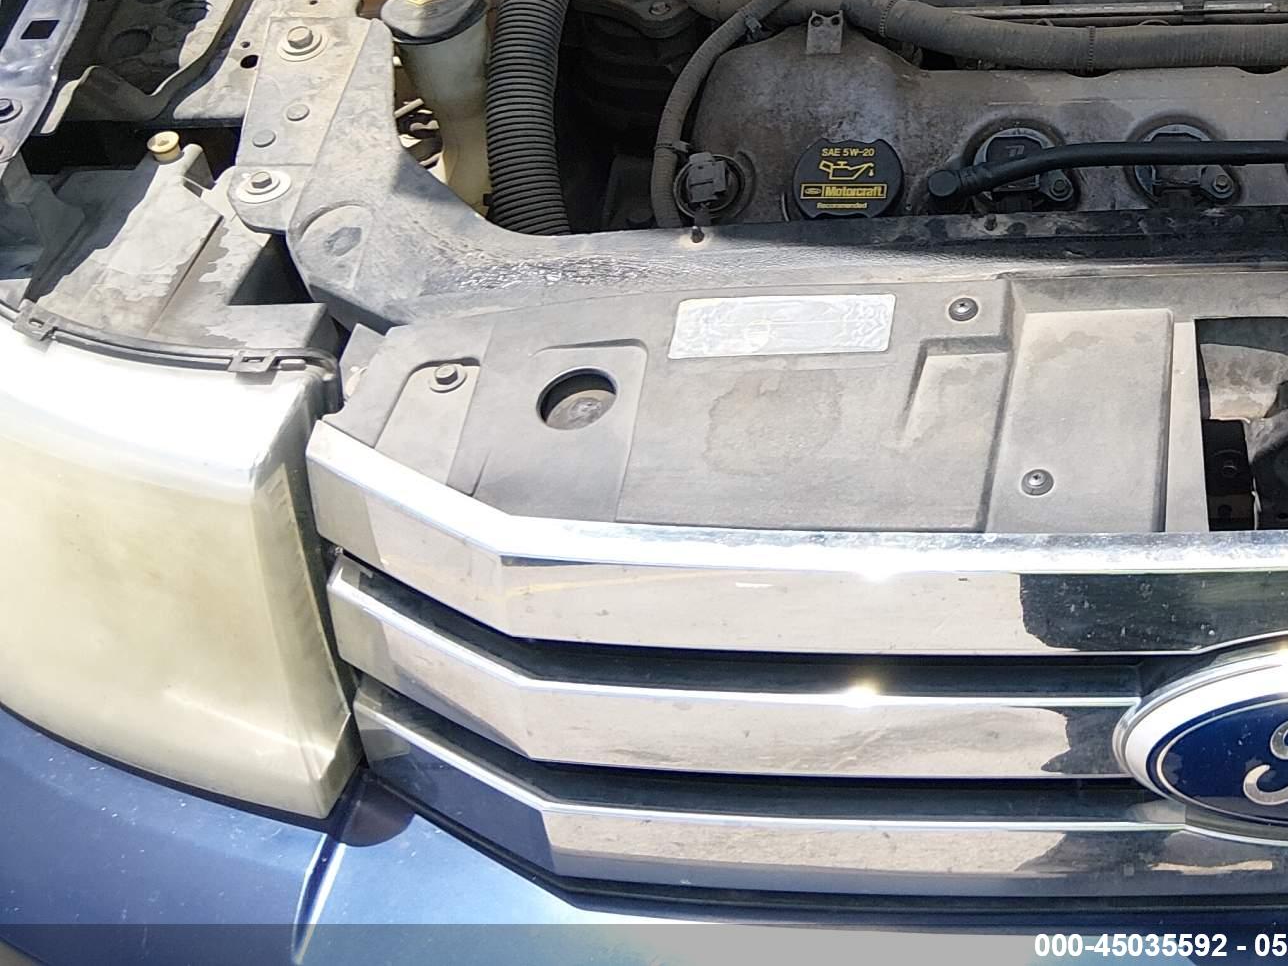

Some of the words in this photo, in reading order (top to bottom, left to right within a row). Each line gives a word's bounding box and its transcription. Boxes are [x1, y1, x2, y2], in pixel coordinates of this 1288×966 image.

[821, 147, 841, 157] SAE
[842, 147, 876, 157] 5W-20
[825, 186, 884, 197] Motorcraft
